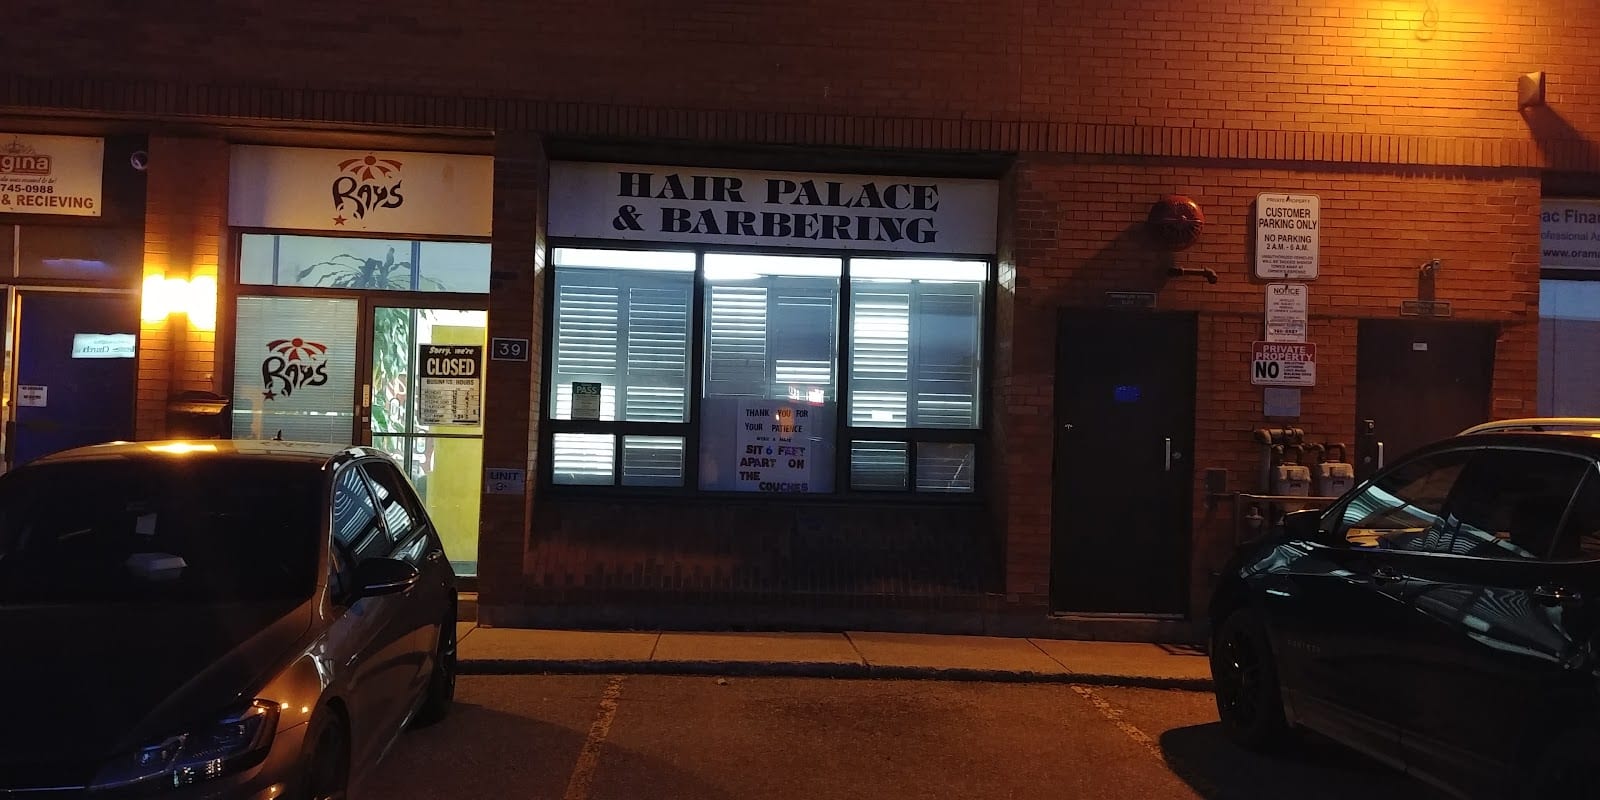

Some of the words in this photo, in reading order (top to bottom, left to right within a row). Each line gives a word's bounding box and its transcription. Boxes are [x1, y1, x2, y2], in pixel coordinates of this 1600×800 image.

[616, 171, 746, 203] HAIR
[764, 178, 939, 213] PALACE
[1, 194, 11, 205] &
[16, 194, 94, 209] RECIEVING
[1266, 207, 1311, 219] CUSTOMER
[612, 204, 645, 232] &
[659, 207, 938, 244] BARBERING
[1259, 218, 1294, 229] PARKING
[1296, 219, 1317, 230] ONLY
[1264, 234, 1276, 242] NO
[1277, 234, 1312, 243] PARKING
[499, 343, 521, 356] 39
[1263, 344, 1306, 354] PRIVATE
[1255, 351, 1313, 362] PROPERTY
[426, 357, 475, 376] CLOSED
[1255, 361, 1279, 379] NO
[576, 385, 598, 394] PASS
[745, 408, 770, 417] THANK
[777, 409, 791, 418] YOU
[796, 409, 809, 418] FOR
[744, 422, 763, 431] YOUR
[771, 424, 803, 433] PATIENCE
[745, 444, 764, 455] SIT
[766, 445, 773, 455] 6
[778, 446, 806, 456] FEET
[739, 457, 776, 468] APART
[788, 458, 805, 469] ON
[490, 471, 519, 480] UNIT
[739, 471, 761, 481] THE
[759, 481, 809, 492] COUCHES
